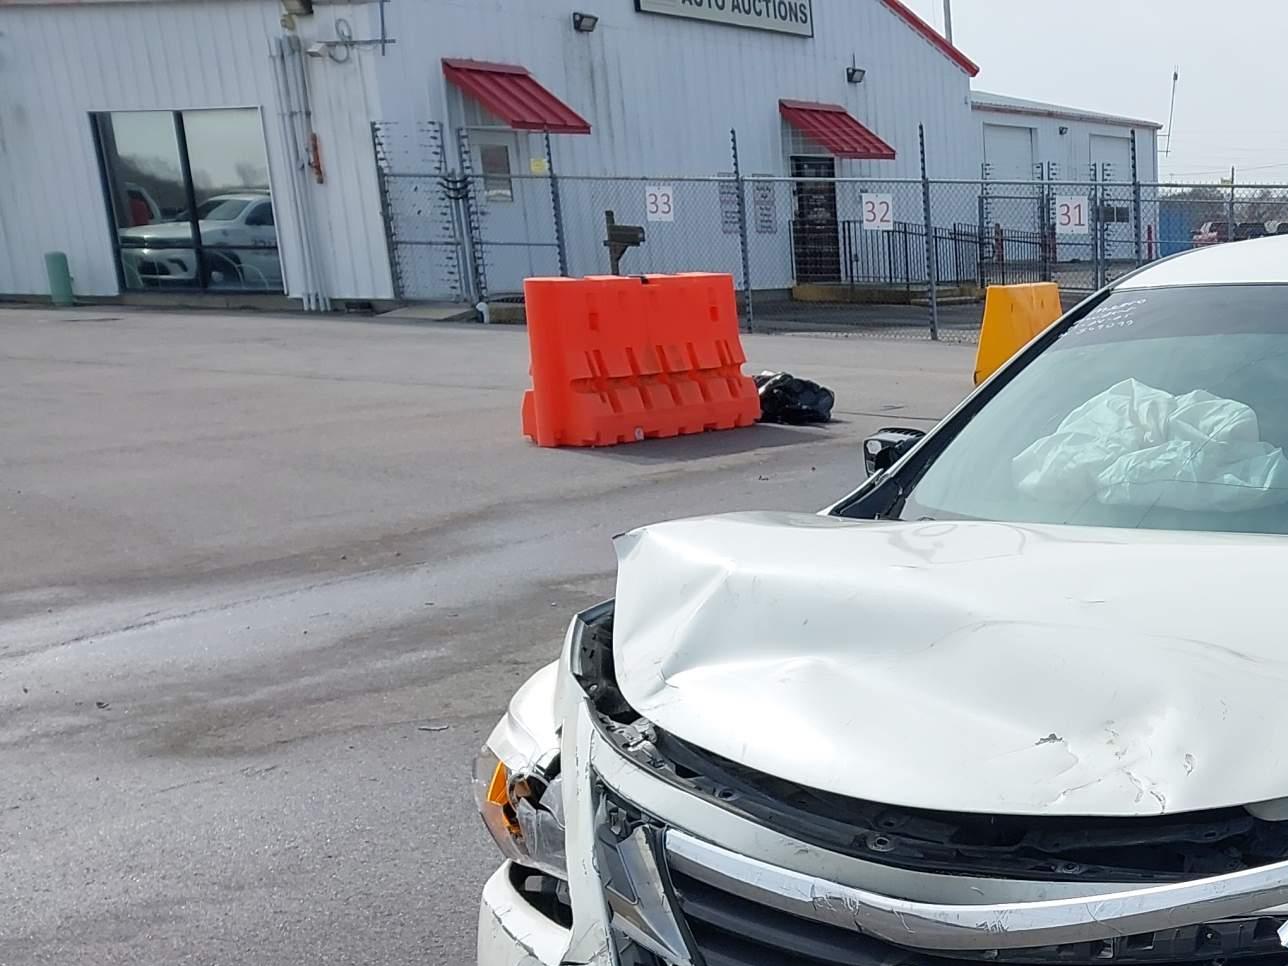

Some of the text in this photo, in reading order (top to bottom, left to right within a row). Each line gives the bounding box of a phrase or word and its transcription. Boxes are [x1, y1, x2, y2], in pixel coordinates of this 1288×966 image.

[730, 0, 808, 24] AUCTIONS
[647, 192, 672, 214] 33
[864, 200, 891, 222] 32
[1059, 203, 1085, 226] 31
